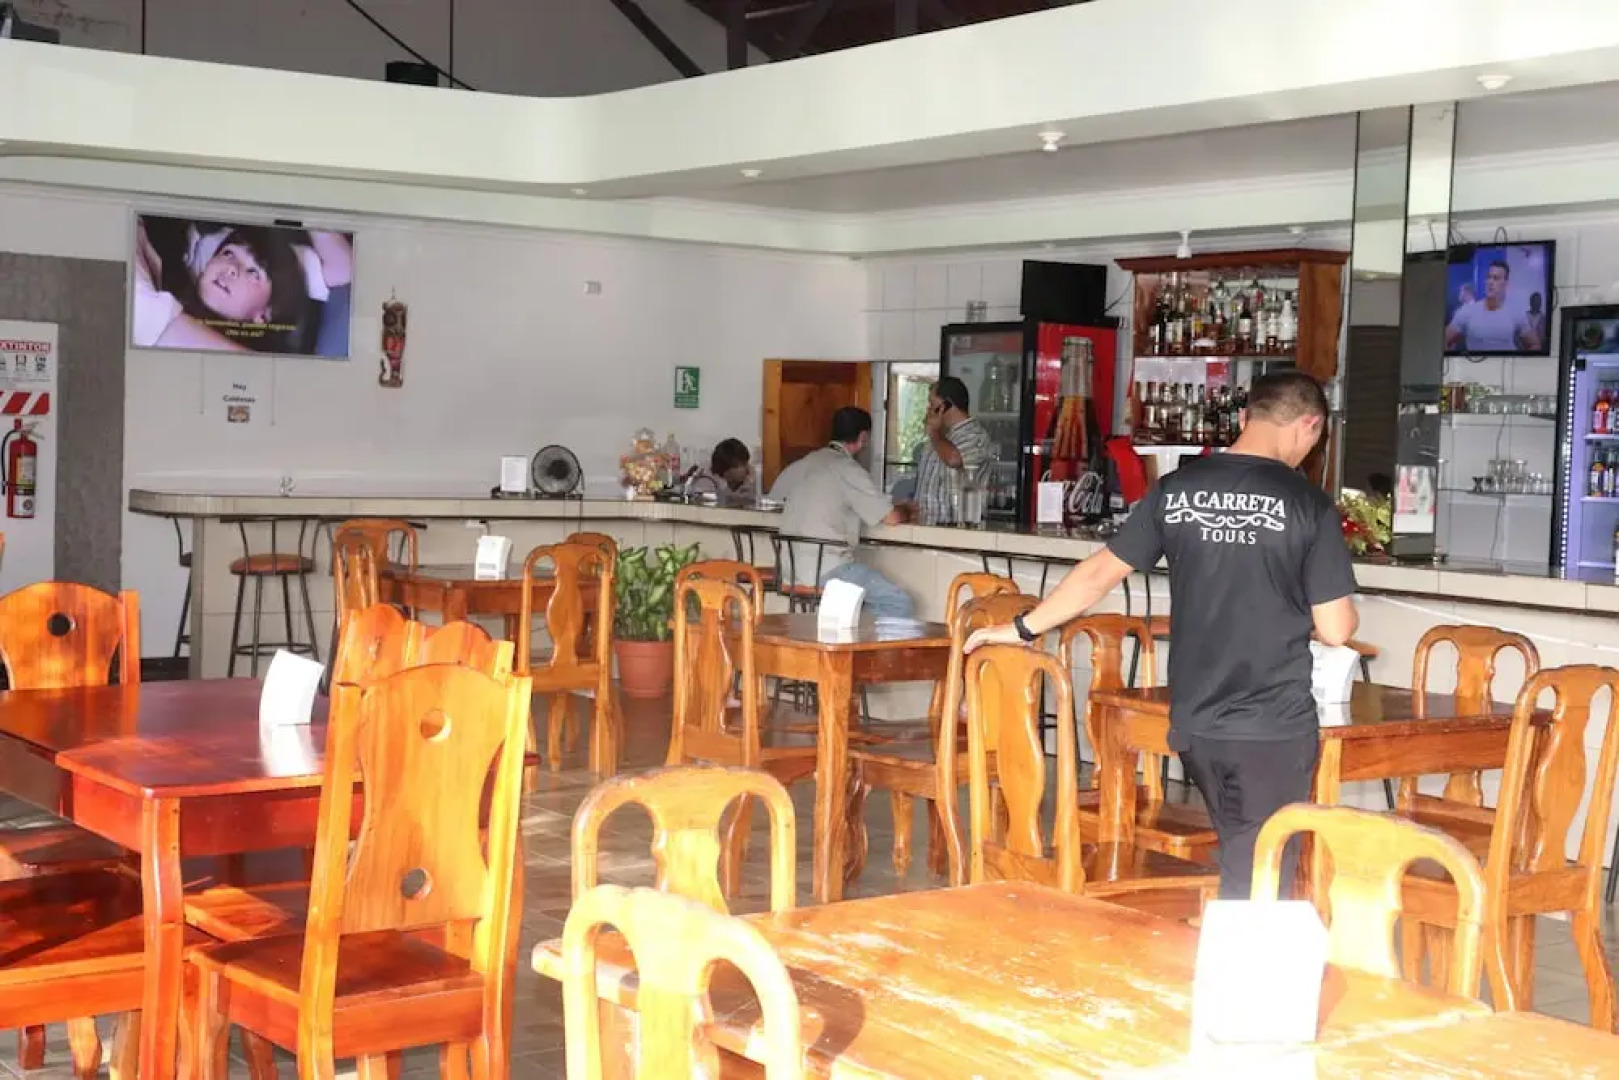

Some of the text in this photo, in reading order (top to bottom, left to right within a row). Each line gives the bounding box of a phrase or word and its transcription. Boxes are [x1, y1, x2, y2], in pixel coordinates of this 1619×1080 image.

[1165, 490, 1286, 518] LA CARRETA
[1200, 527, 1257, 545] TOURS
